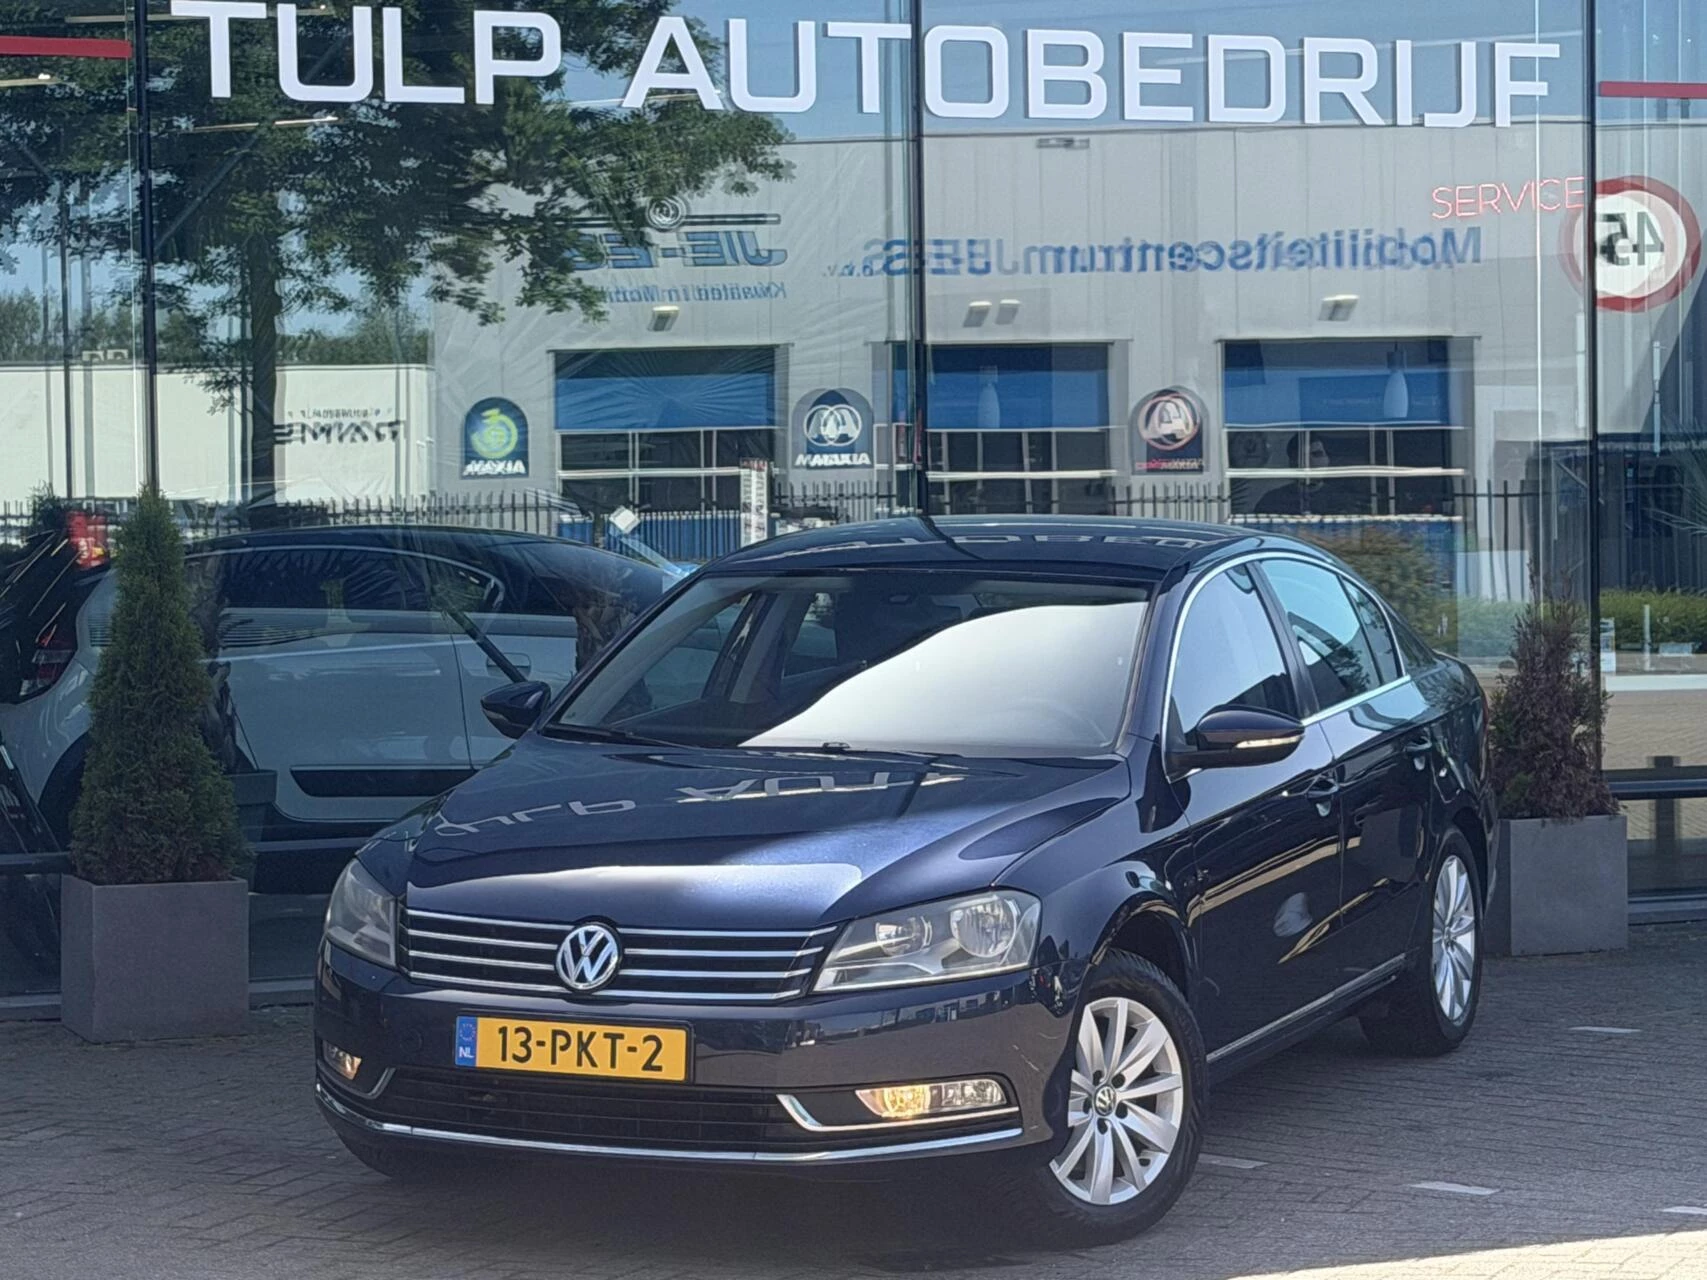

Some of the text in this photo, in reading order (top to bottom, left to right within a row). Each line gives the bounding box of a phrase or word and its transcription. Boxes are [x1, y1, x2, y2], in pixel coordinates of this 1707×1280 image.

[170, 0, 1561, 128] TULP AUTOBEDRIJF
[1431, 176, 1585, 220] SERVICE
[458, 1046, 475, 1059] NL
[498, 1026, 664, 1072] 13-PKT-2
